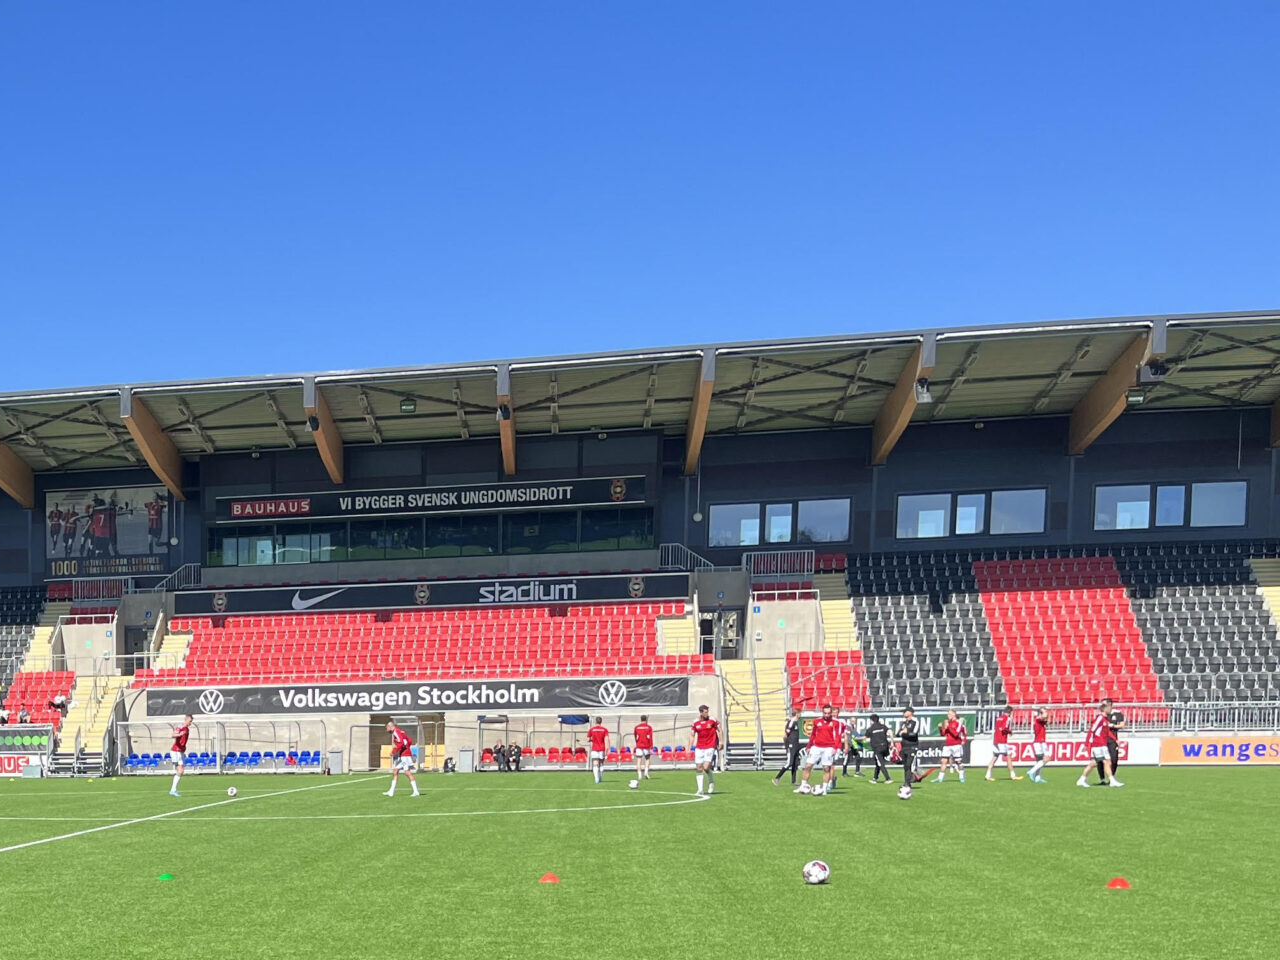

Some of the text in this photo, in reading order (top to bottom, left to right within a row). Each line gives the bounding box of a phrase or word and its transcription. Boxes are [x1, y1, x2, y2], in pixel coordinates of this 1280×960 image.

[233, 501, 310, 515] BAUHAUS
[340, 486, 573, 510] VI BYGGER SVENSK UNGDOMSIDROTT
[51, 560, 78, 576] 1000
[479, 580, 577, 603] stadium
[278, 684, 539, 710] Volkswagen Stockholm
